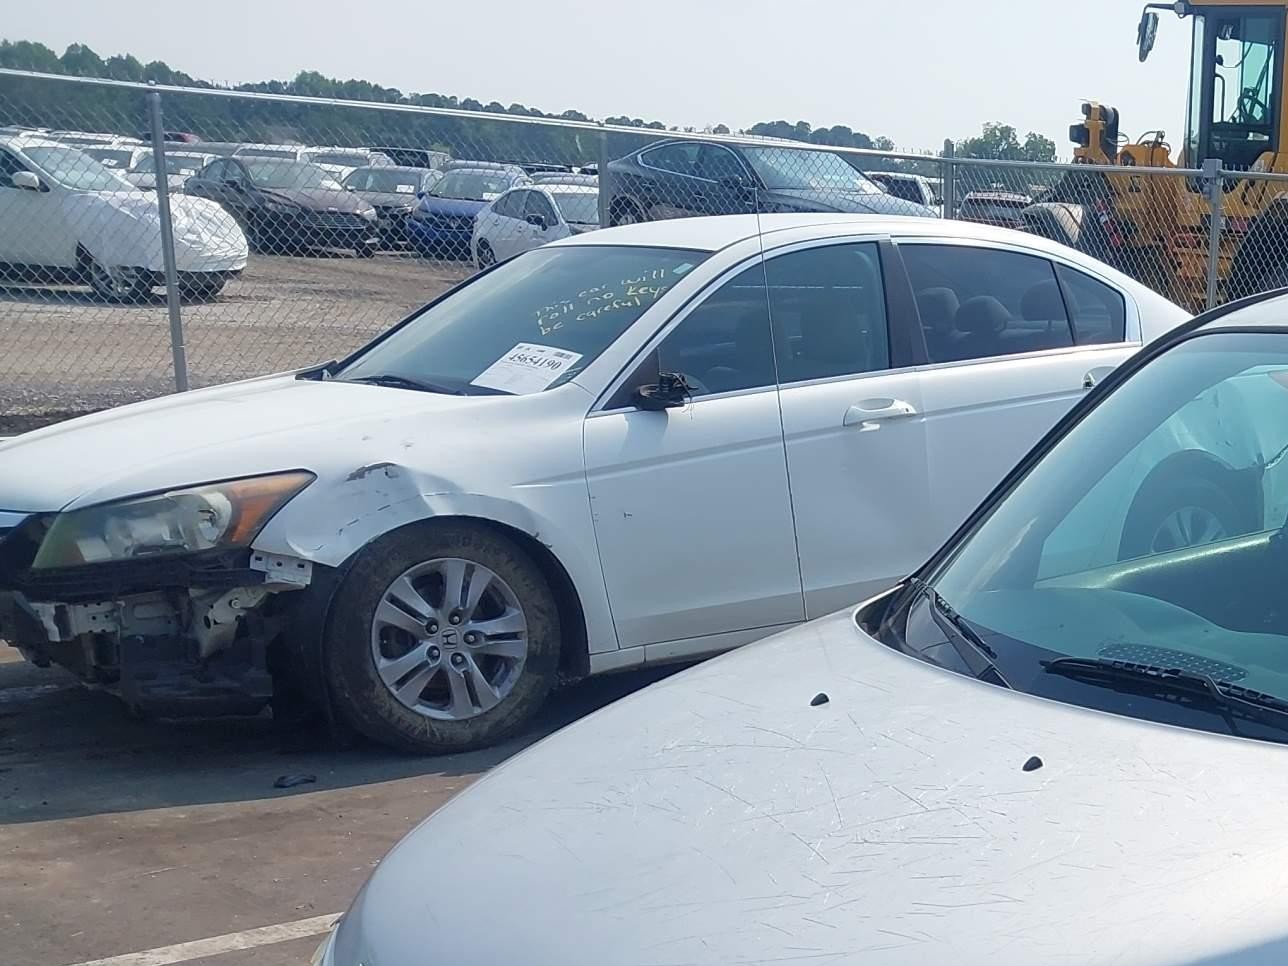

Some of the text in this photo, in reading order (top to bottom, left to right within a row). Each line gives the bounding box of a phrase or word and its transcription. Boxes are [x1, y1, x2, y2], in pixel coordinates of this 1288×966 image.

[578, 283, 607, 298] car
[620, 269, 665, 285] will
[537, 303, 575, 326] roll
[587, 292, 614, 305] no
[540, 297, 642, 337] be careful
[509, 353, 562, 371] 45654190
